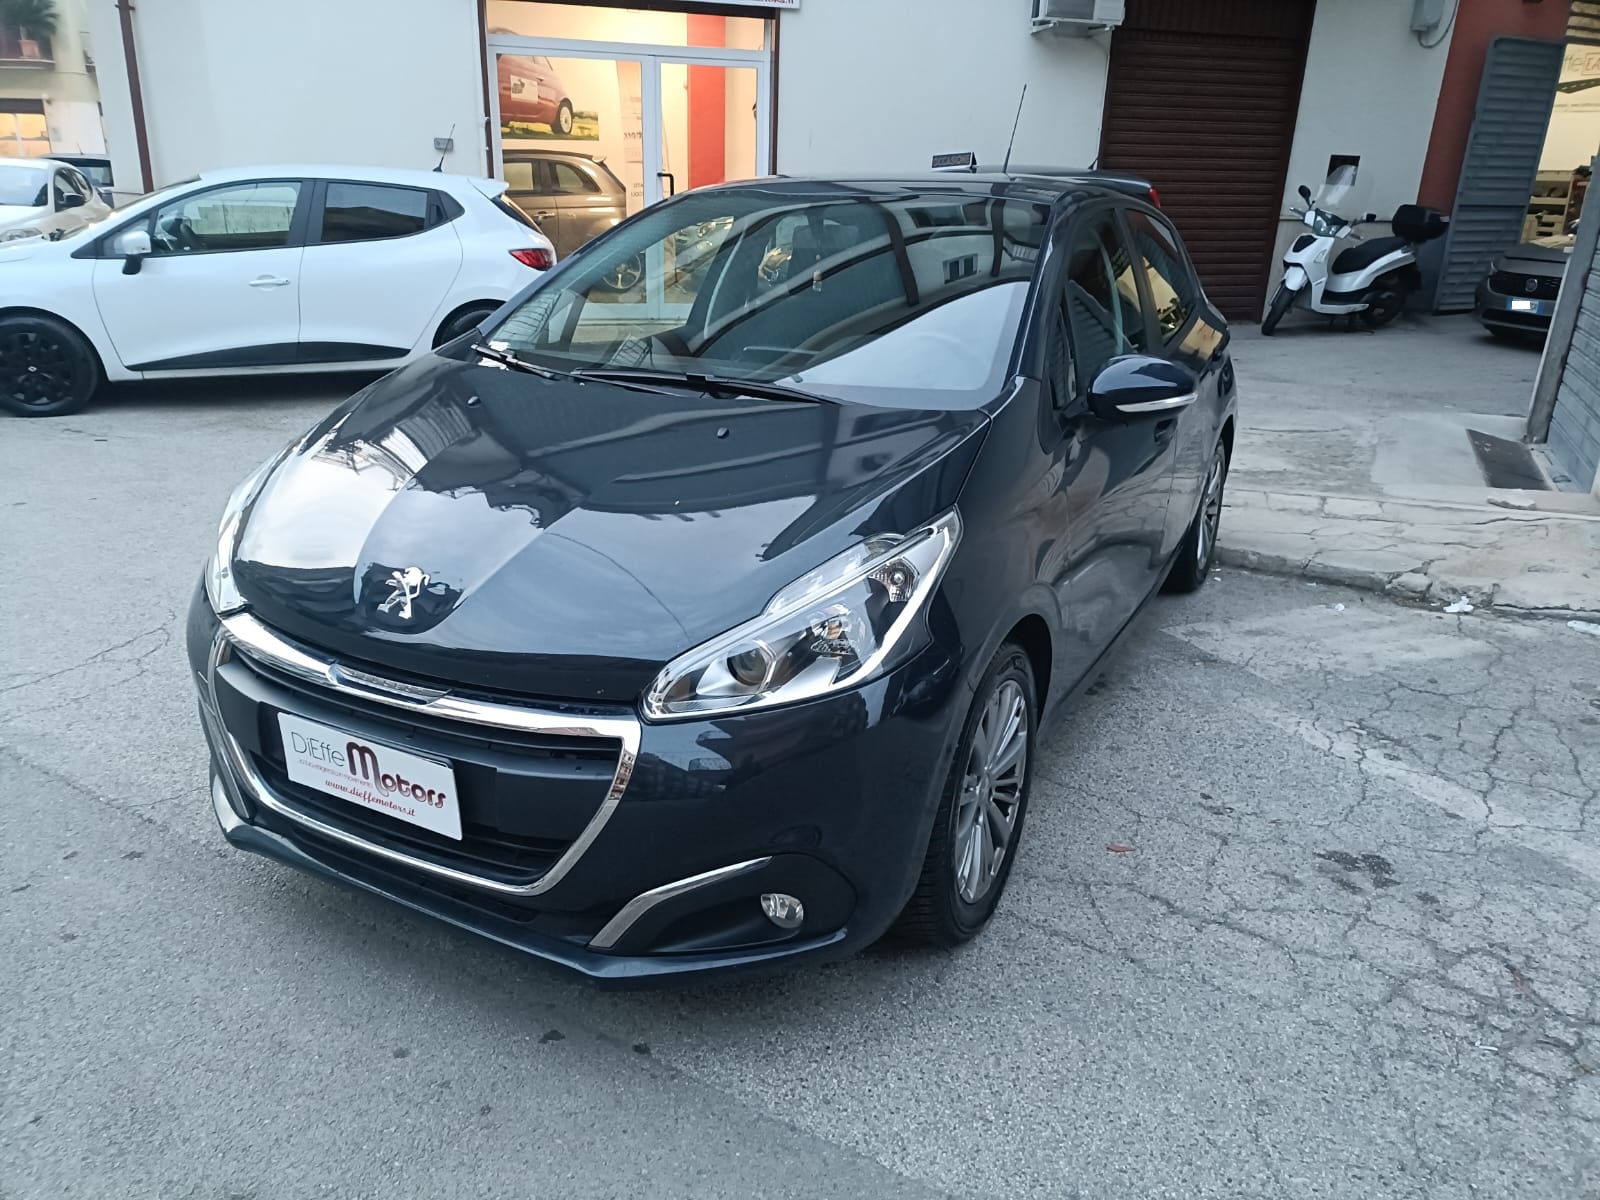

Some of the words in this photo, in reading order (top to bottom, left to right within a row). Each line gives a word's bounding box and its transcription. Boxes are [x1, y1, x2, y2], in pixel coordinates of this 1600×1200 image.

[291, 731, 346, 768] DiEffe
[346, 741, 447, 809] Motors
[324, 778, 416, 817] www.dieffemotors.it
